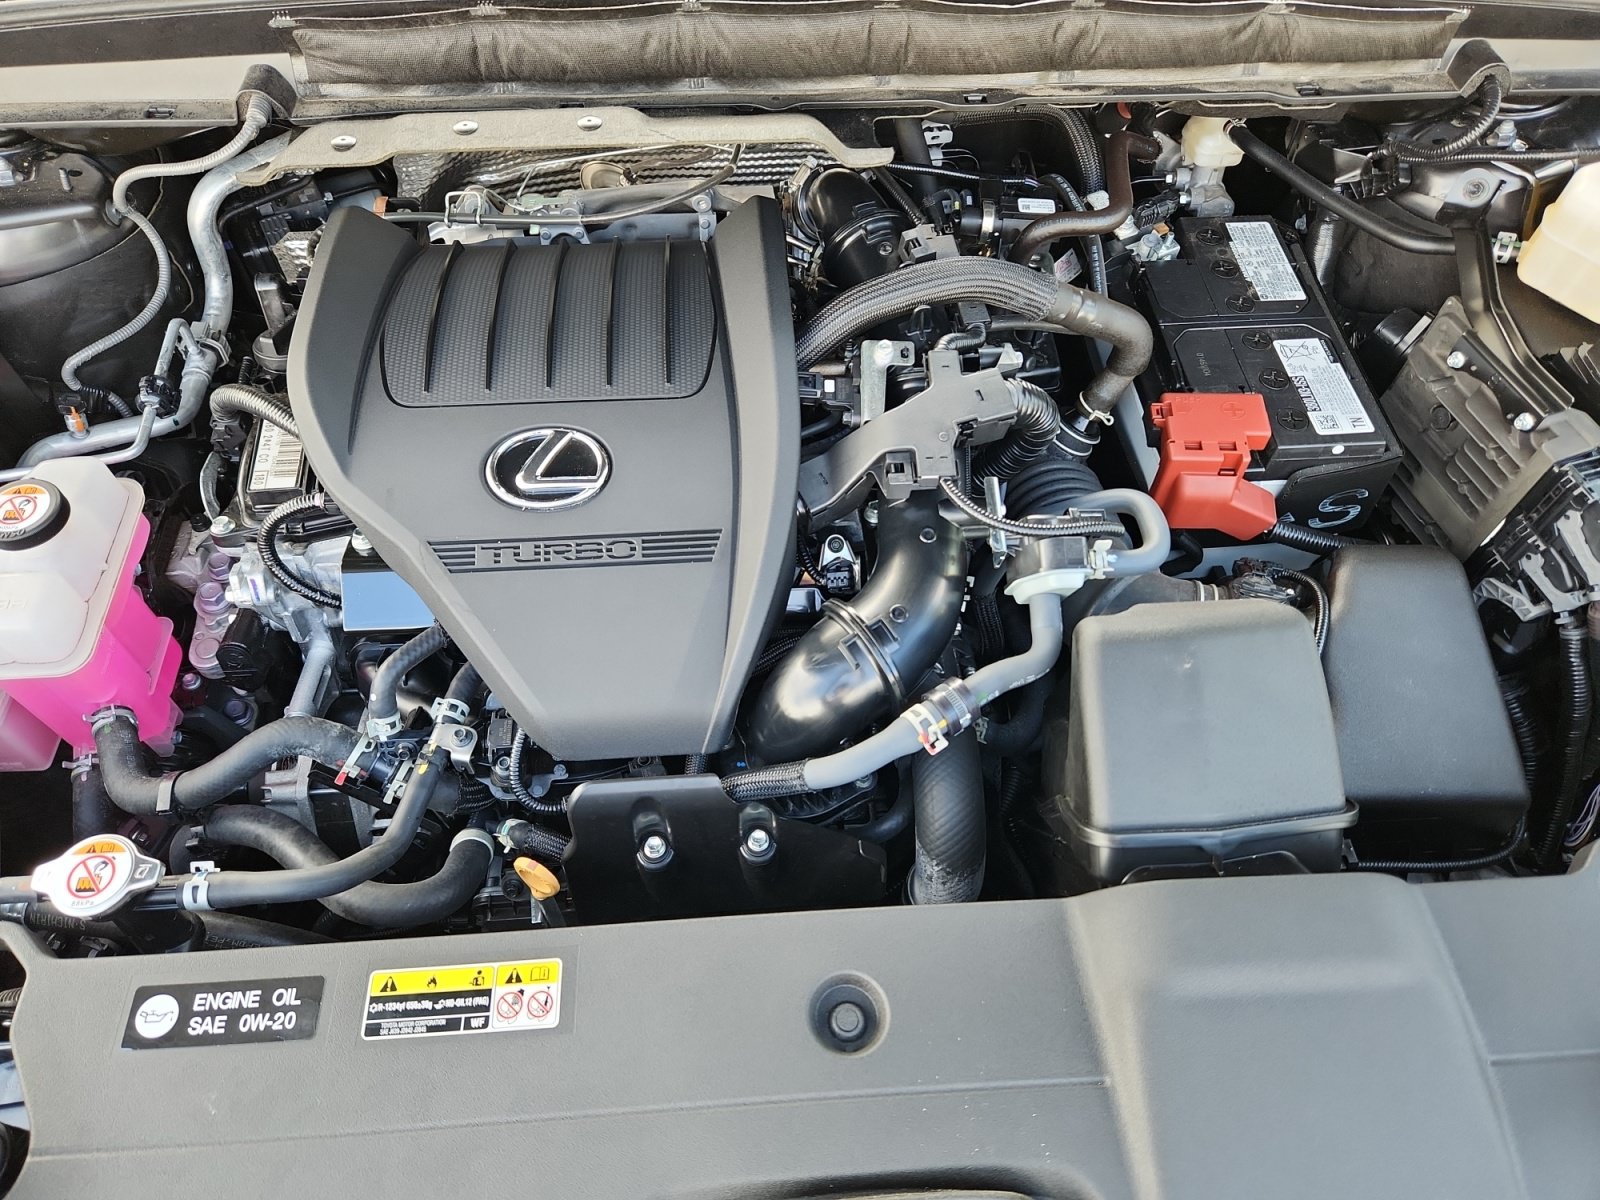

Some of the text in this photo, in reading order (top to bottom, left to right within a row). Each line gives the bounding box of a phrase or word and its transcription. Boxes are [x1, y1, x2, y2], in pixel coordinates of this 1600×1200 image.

[479, 539, 637, 565] TURBO
[192, 987, 302, 1012] ENGINE OIL
[187, 1011, 297, 1036] SAE 0W-20
[470, 1017, 485, 1028] WF
